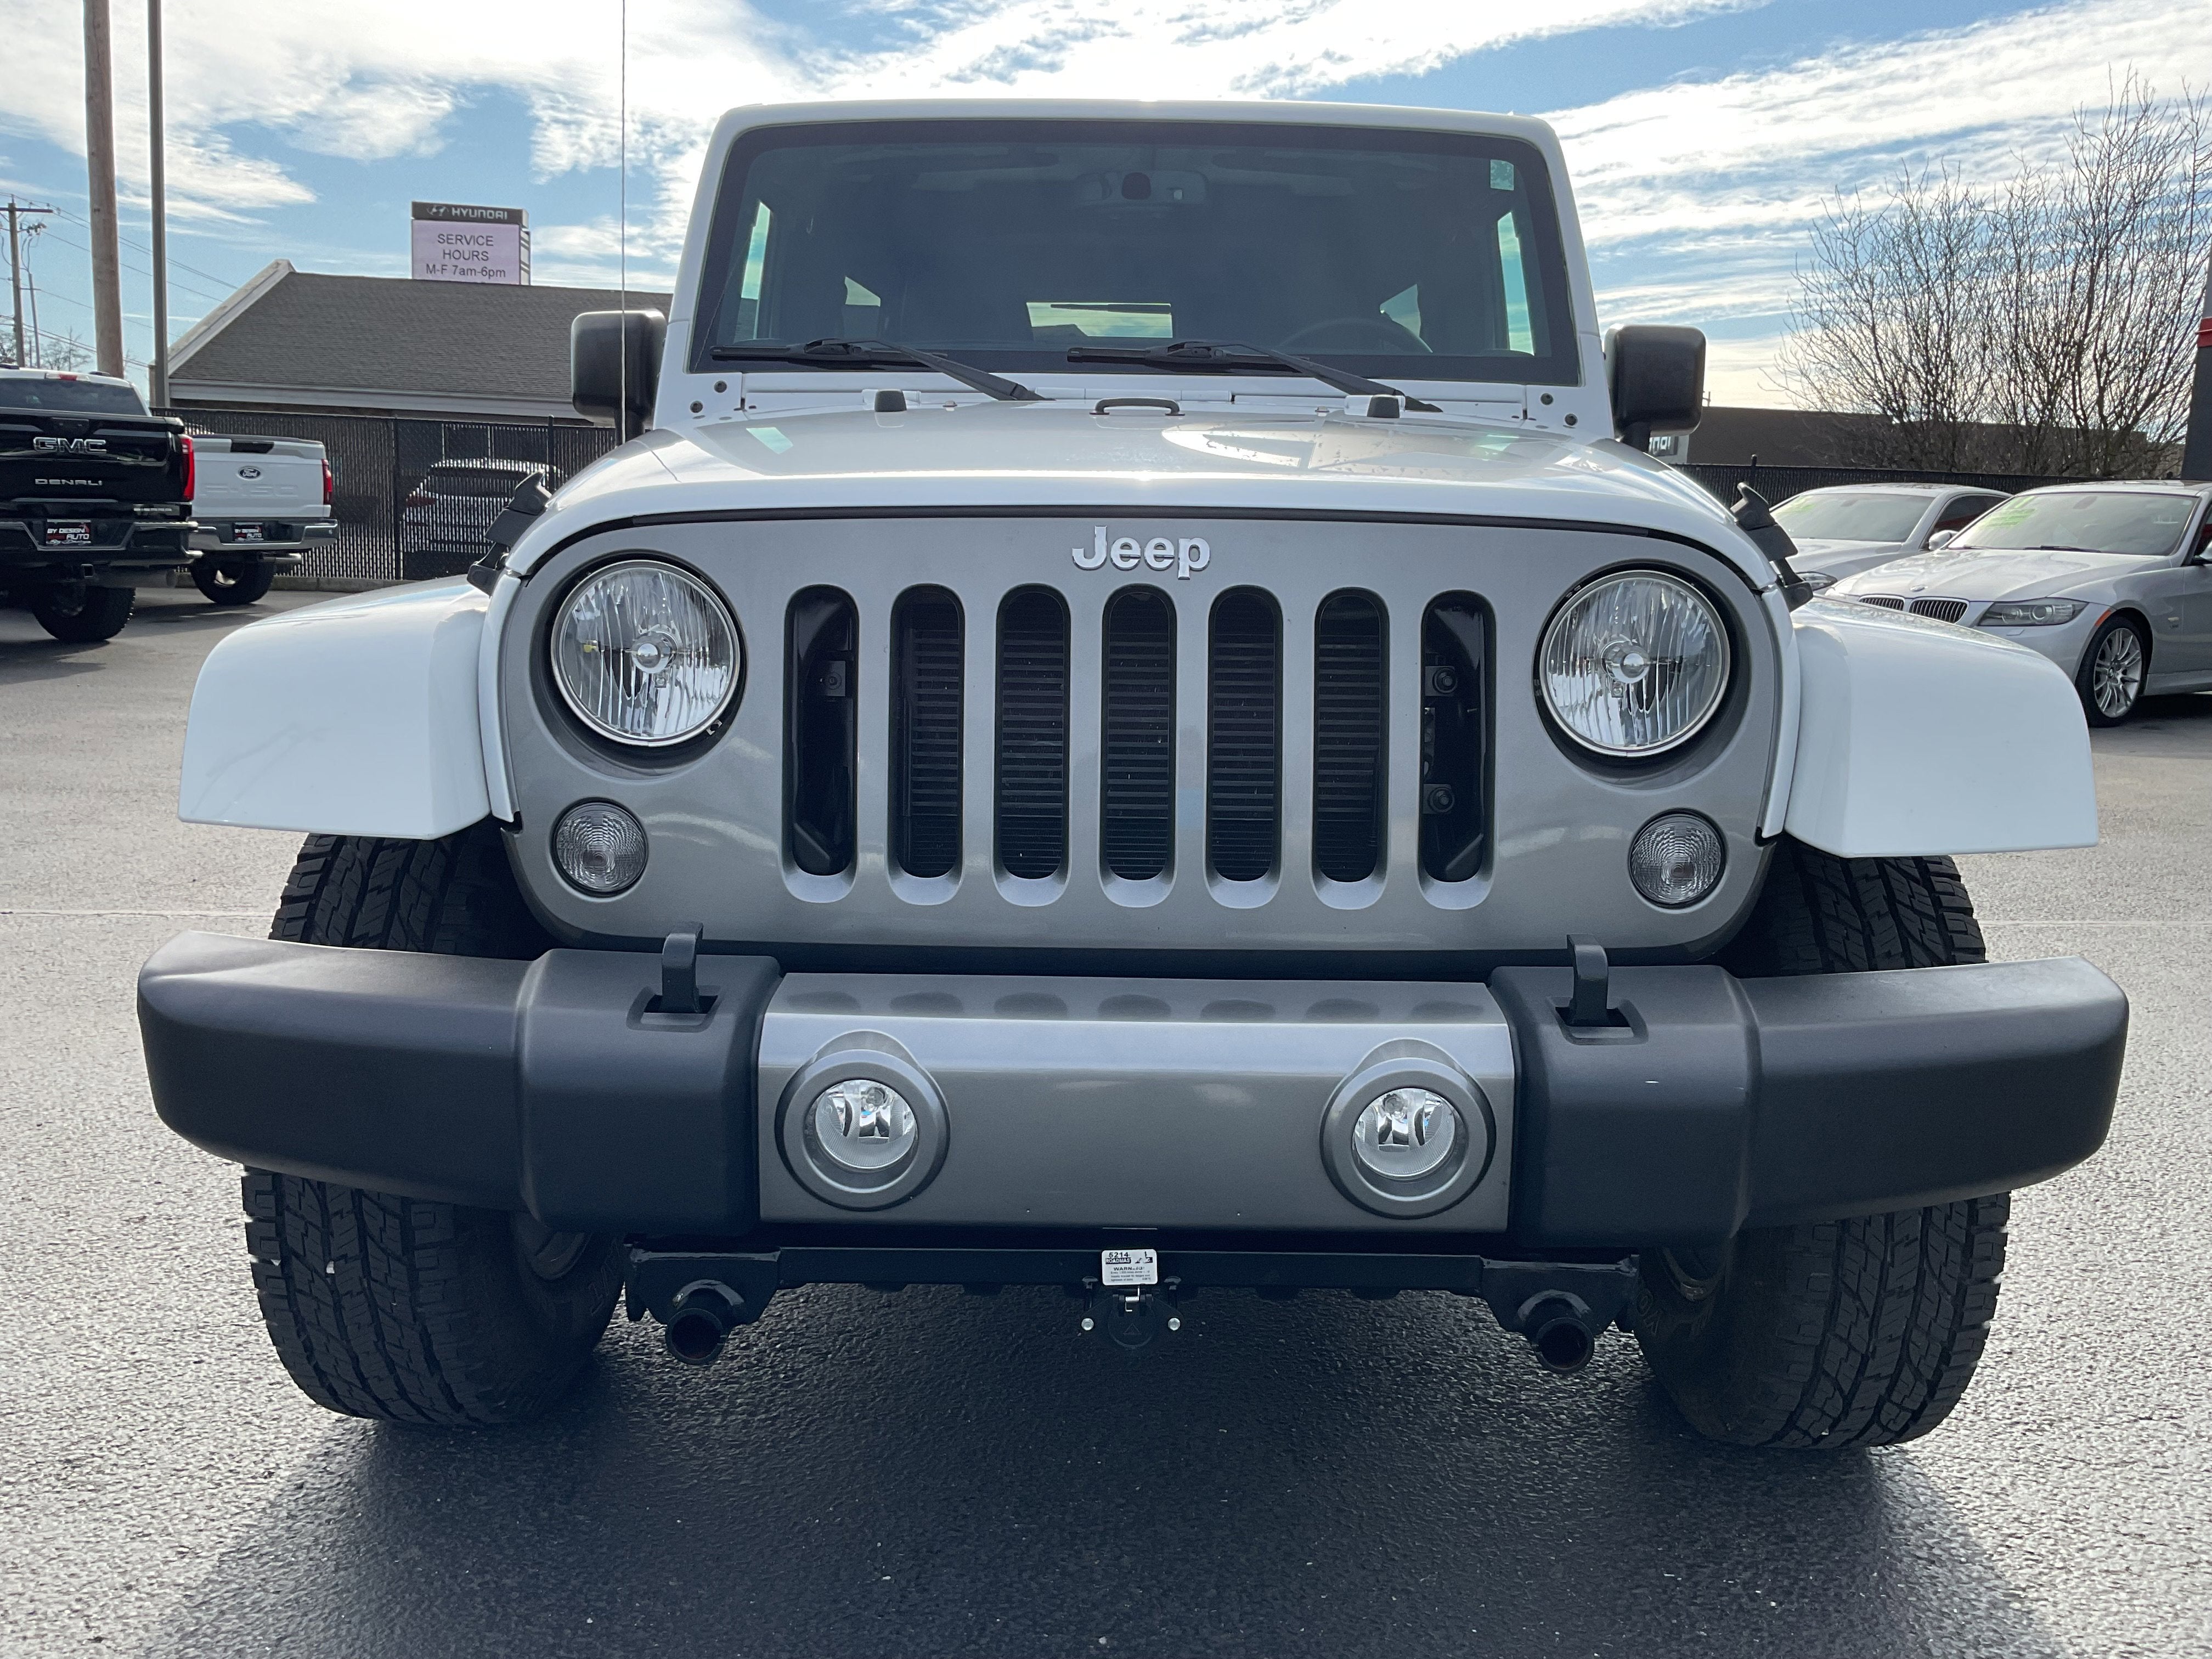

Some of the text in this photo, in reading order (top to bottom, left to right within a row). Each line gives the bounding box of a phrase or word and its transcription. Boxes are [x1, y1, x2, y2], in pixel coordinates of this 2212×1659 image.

[452, 207, 507, 219] HYUNDAI
[437, 233, 494, 246] SERVICE
[442, 249, 489, 261] HOURS
[426, 263, 506, 279] M-F 7am-6pm
[33, 437, 106, 454] GMC
[1071, 526, 1211, 580] Jeep
